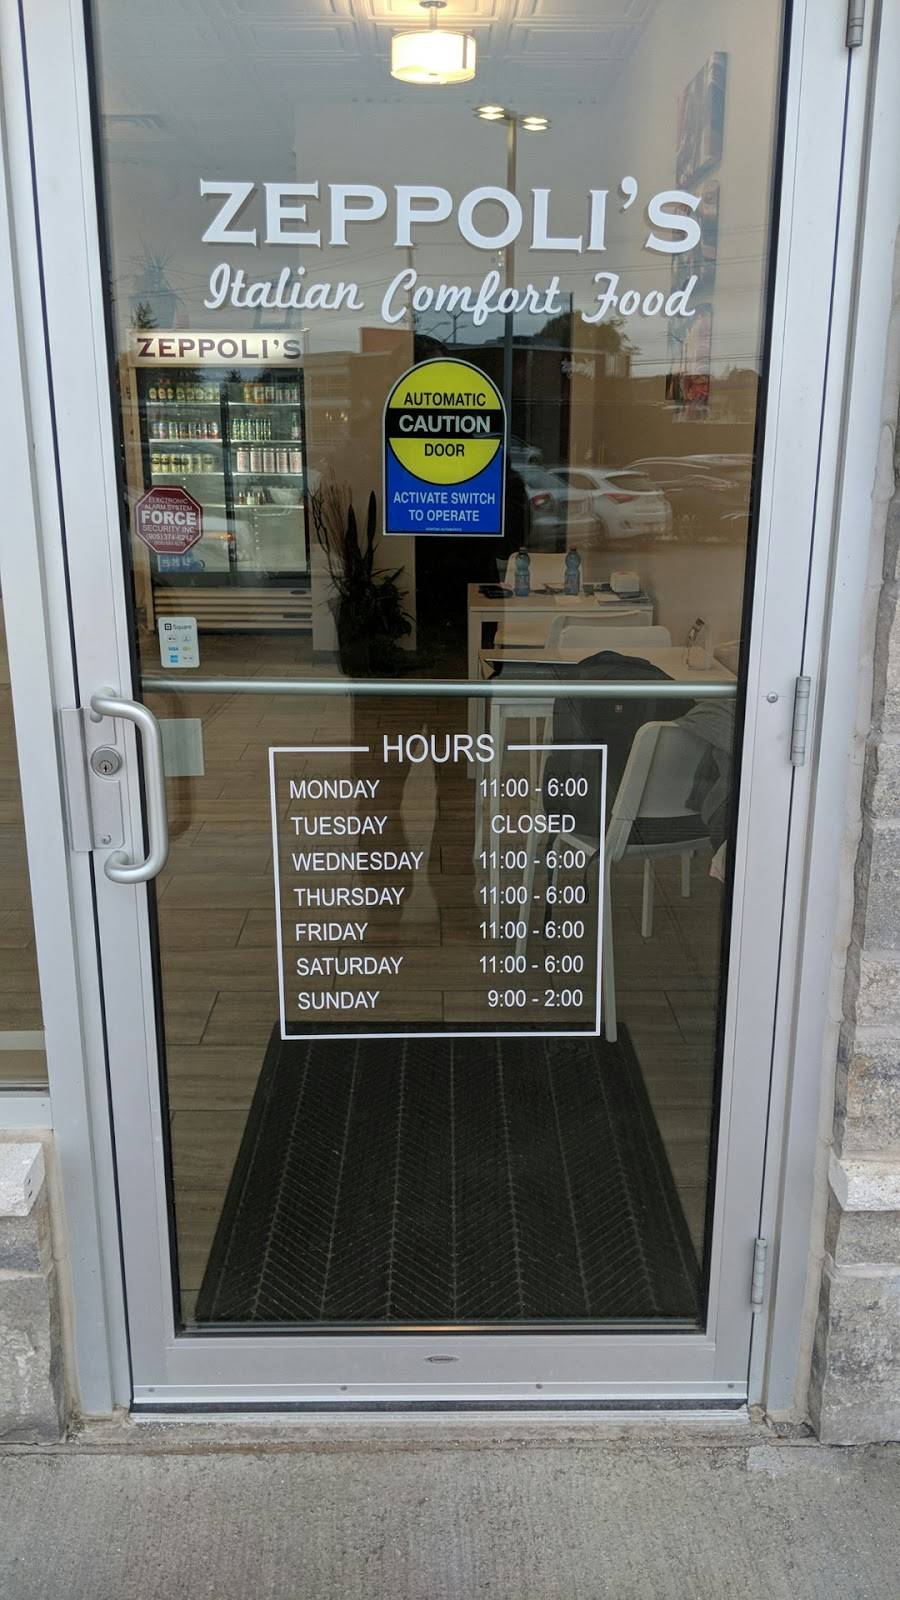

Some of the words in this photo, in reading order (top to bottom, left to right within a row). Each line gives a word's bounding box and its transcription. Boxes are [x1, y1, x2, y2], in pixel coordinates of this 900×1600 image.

[199, 176, 702, 254] ZEPPOLI'S
[204, 263, 364, 311] Italian
[381, 268, 562, 326] Comfort
[581, 272, 698, 323] Food
[136, 337, 301, 360] ZEPPOLI'S
[403, 392, 487, 407] AUTOMATIC
[398, 414, 491, 433] CAUTION
[424, 443, 465, 457] DOOR
[144, 503, 166, 511] ALARM
[167, 504, 192, 512] SYSTEM
[148, 496, 188, 505] ELECTRONIC
[393, 491, 448, 504] ACTIVATE
[451, 492, 496, 505] SWITCH
[141, 510, 197, 526] FORCE
[408, 509, 424, 521] TO
[427, 509, 480, 522] OPERATE
[142, 524, 179, 533] SECURITY
[382, 734, 495, 764] HOURS
[289, 779, 380, 799] MONDAY
[479, 778, 529, 798] 11:00
[548, 777, 589, 797] 6:00
[290, 816, 388, 836] TUESDAY
[491, 814, 577, 834] CLOSED
[292, 851, 425, 871] WEDNESDAY
[479, 851, 527, 869] 11:00
[546, 850, 586, 869] 6:00
[294, 887, 405, 906] THURSDAY
[479, 886, 527, 905] 11:00
[546, 886, 586, 904] 6:00
[295, 922, 369, 941] FRIDAY
[479, 921, 526, 939] 11:00
[545, 920, 585, 939] 6:00
[296, 956, 404, 976] SATURDAY
[479, 955, 526, 973] 11:00
[544, 955, 584, 973] 6:00
[297, 991, 380, 1010] SUNDAY
[487, 989, 526, 1007] 9:00
[544, 989, 583, 1007] 2:00
